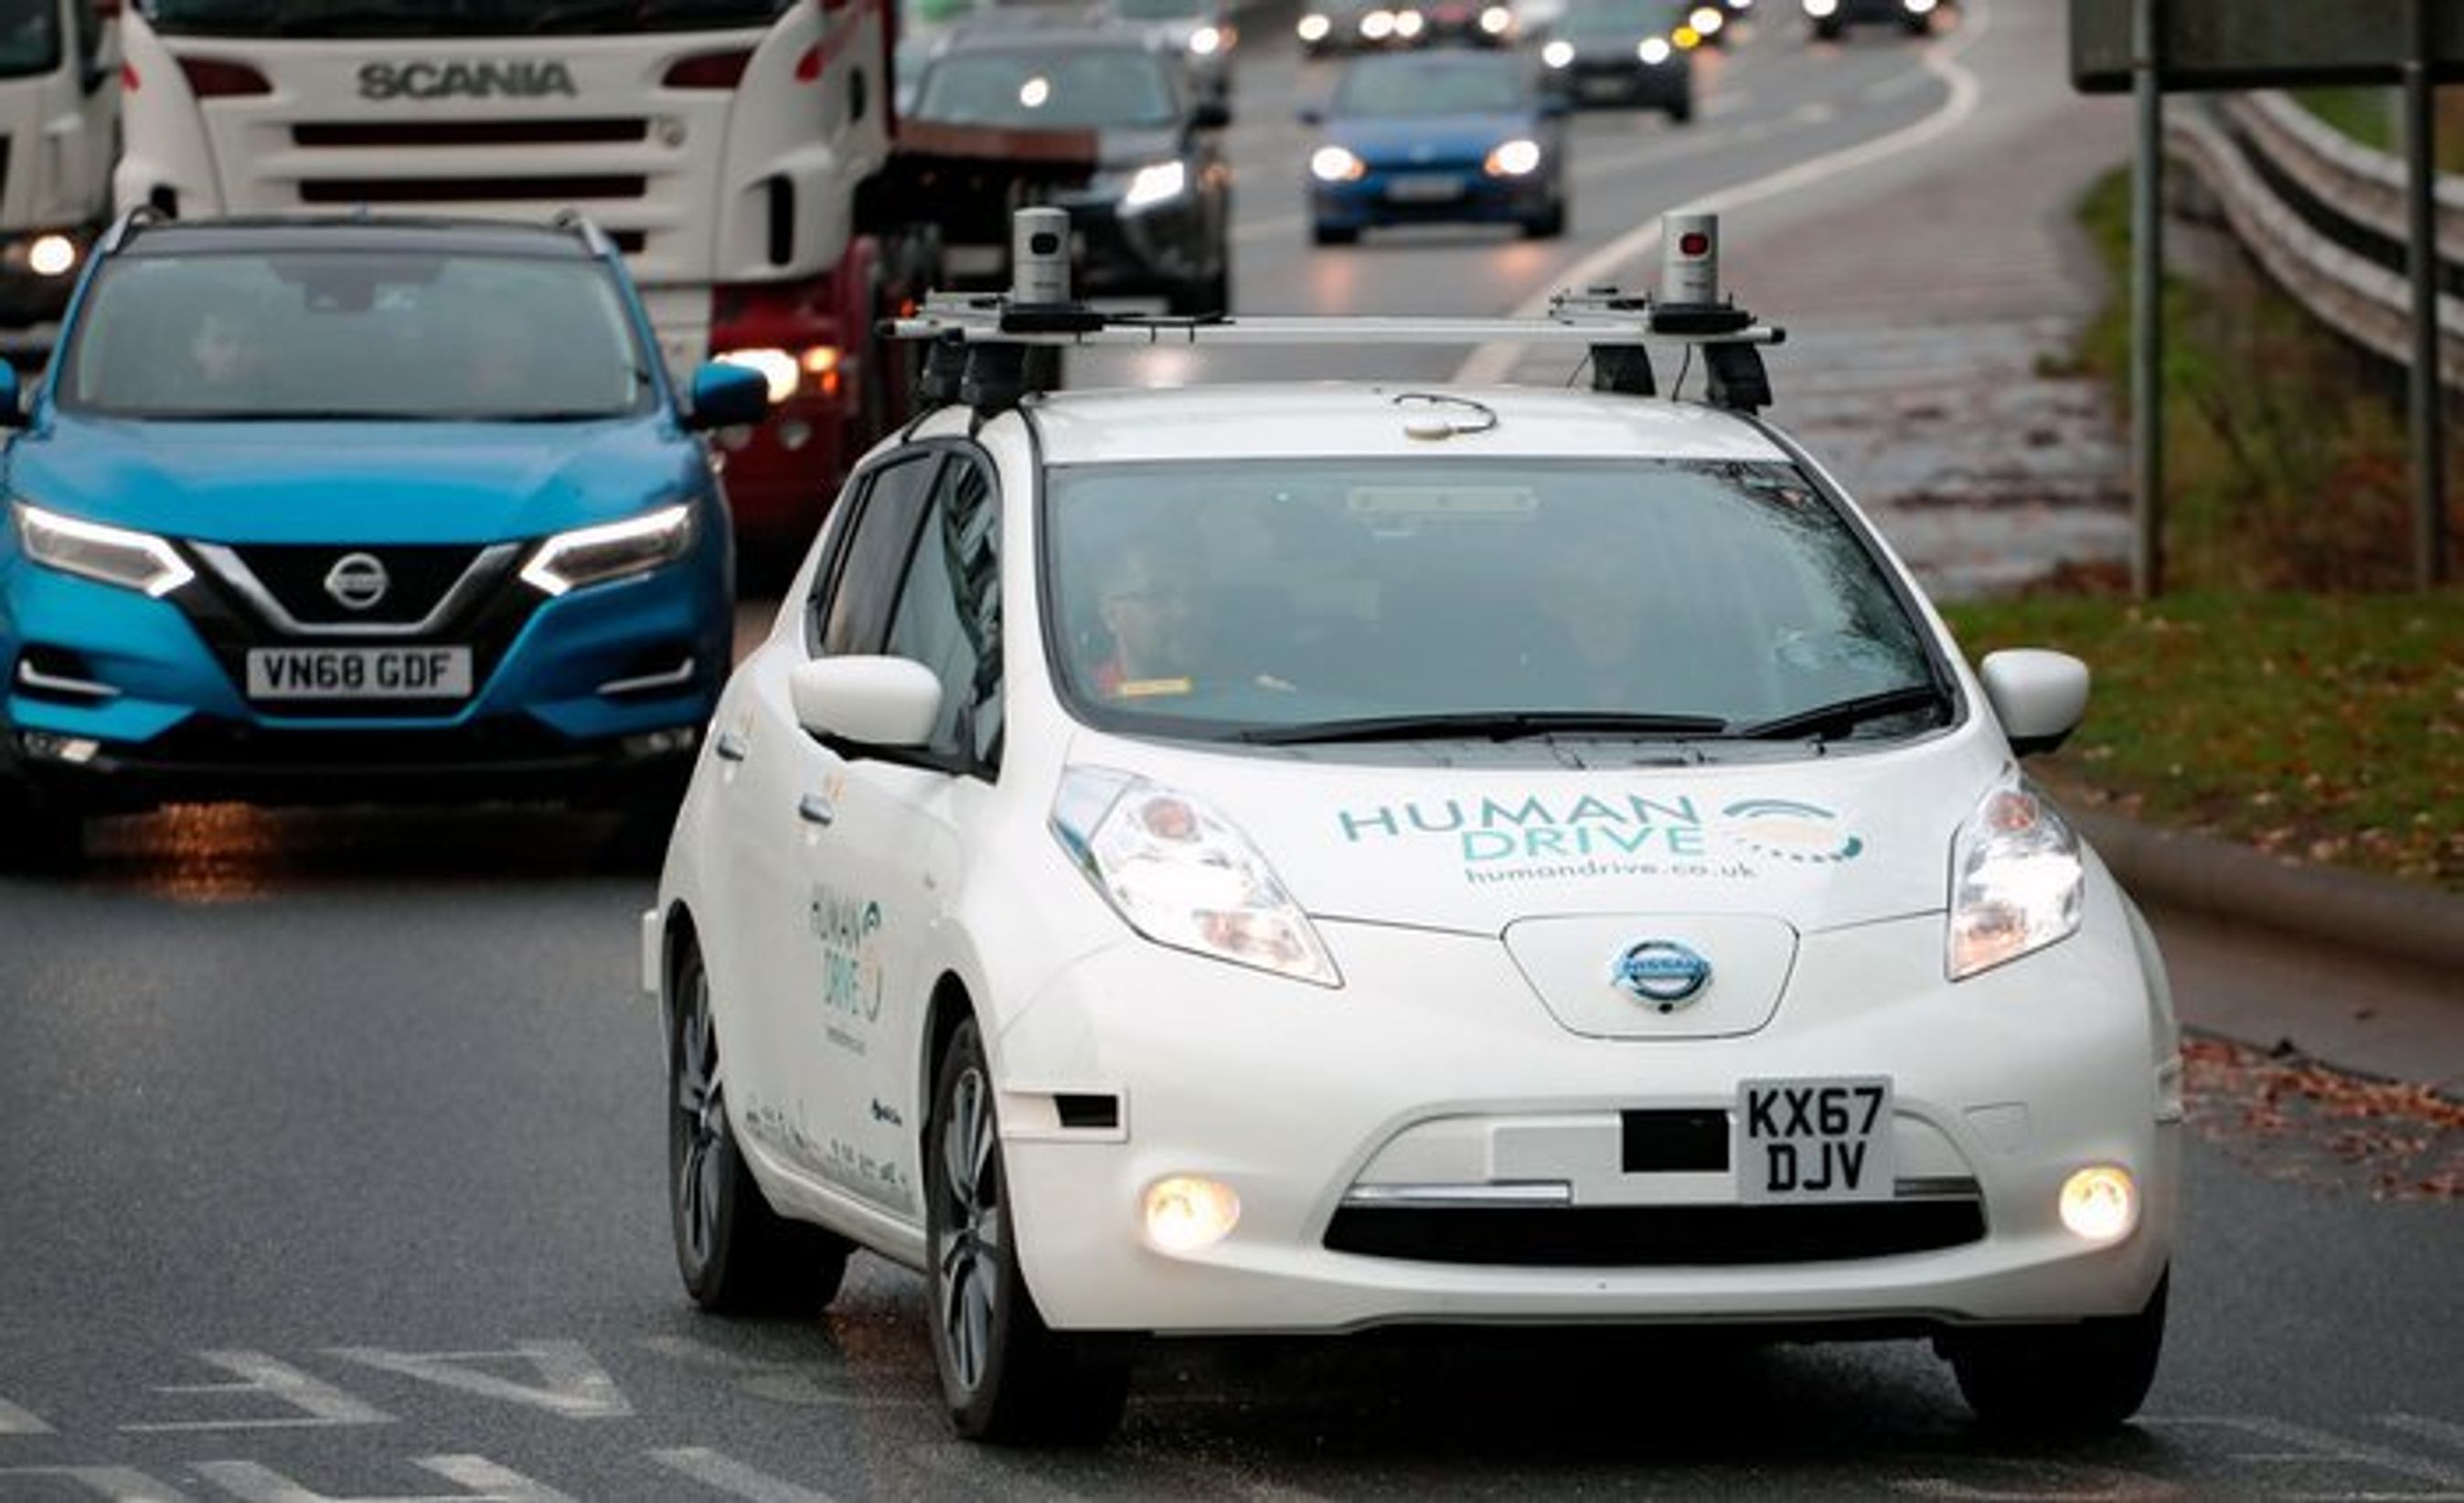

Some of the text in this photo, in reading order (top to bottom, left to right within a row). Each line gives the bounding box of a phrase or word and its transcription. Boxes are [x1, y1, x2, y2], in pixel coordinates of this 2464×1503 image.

[357, 61, 580, 101] SCANIA
[263, 652, 452, 689] VN68 GDF
[1338, 793, 1701, 843] HUMAN
[1463, 826, 1707, 861] DRIVE
[1465, 859, 1757, 884] humandrive.co.uk
[1748, 1084, 1884, 1138] KX67
[1766, 1141, 1866, 1193] DJV
